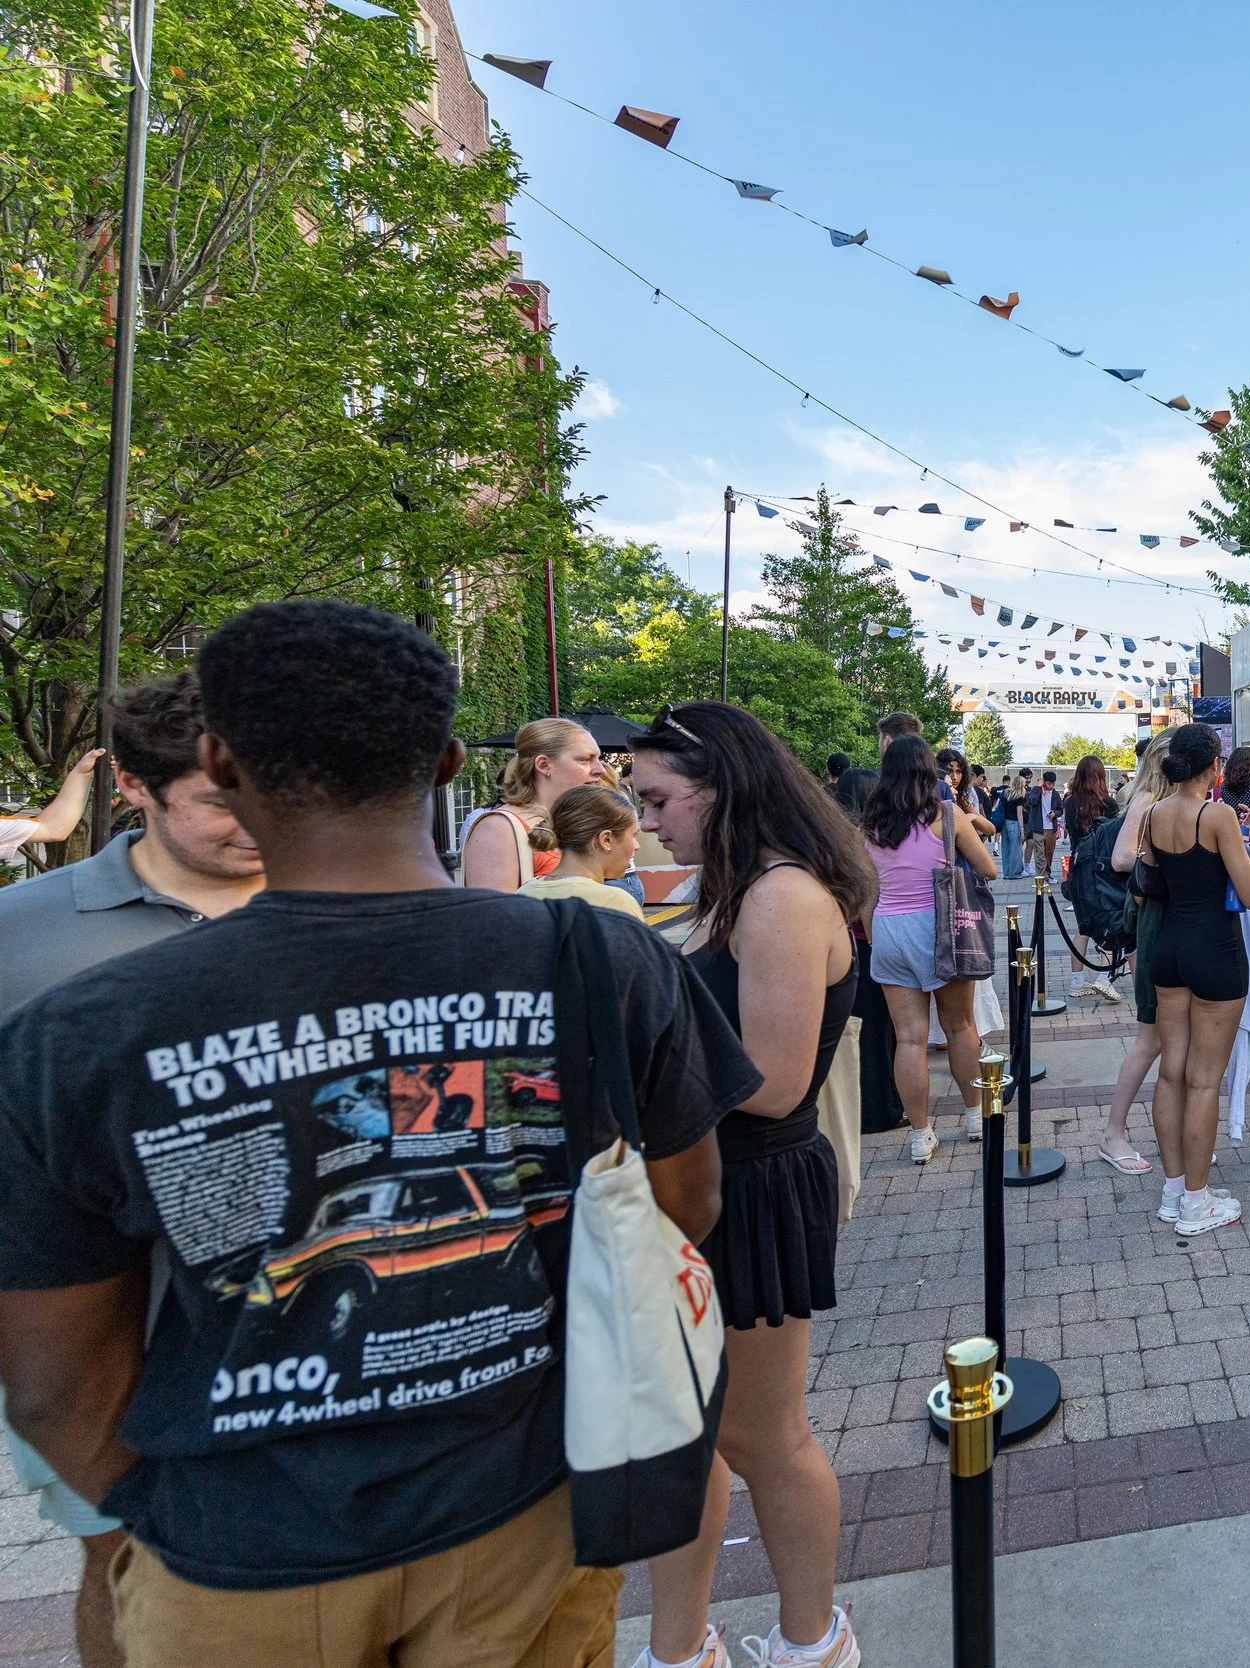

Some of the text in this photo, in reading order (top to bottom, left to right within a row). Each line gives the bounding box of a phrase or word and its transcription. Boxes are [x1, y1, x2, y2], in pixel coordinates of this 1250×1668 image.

[1007, 690, 1097, 705] BLOCK PARTY
[146, 991, 554, 1081] BLAZE A BRONCO TRA
[166, 1018, 556, 1108] TO WHERE THE FUN IS
[213, 1408, 276, 1433] new
[276, 1387, 382, 1426] 4-wheel
[387, 1380, 454, 1407] drive
[459, 1356, 518, 1390] from
